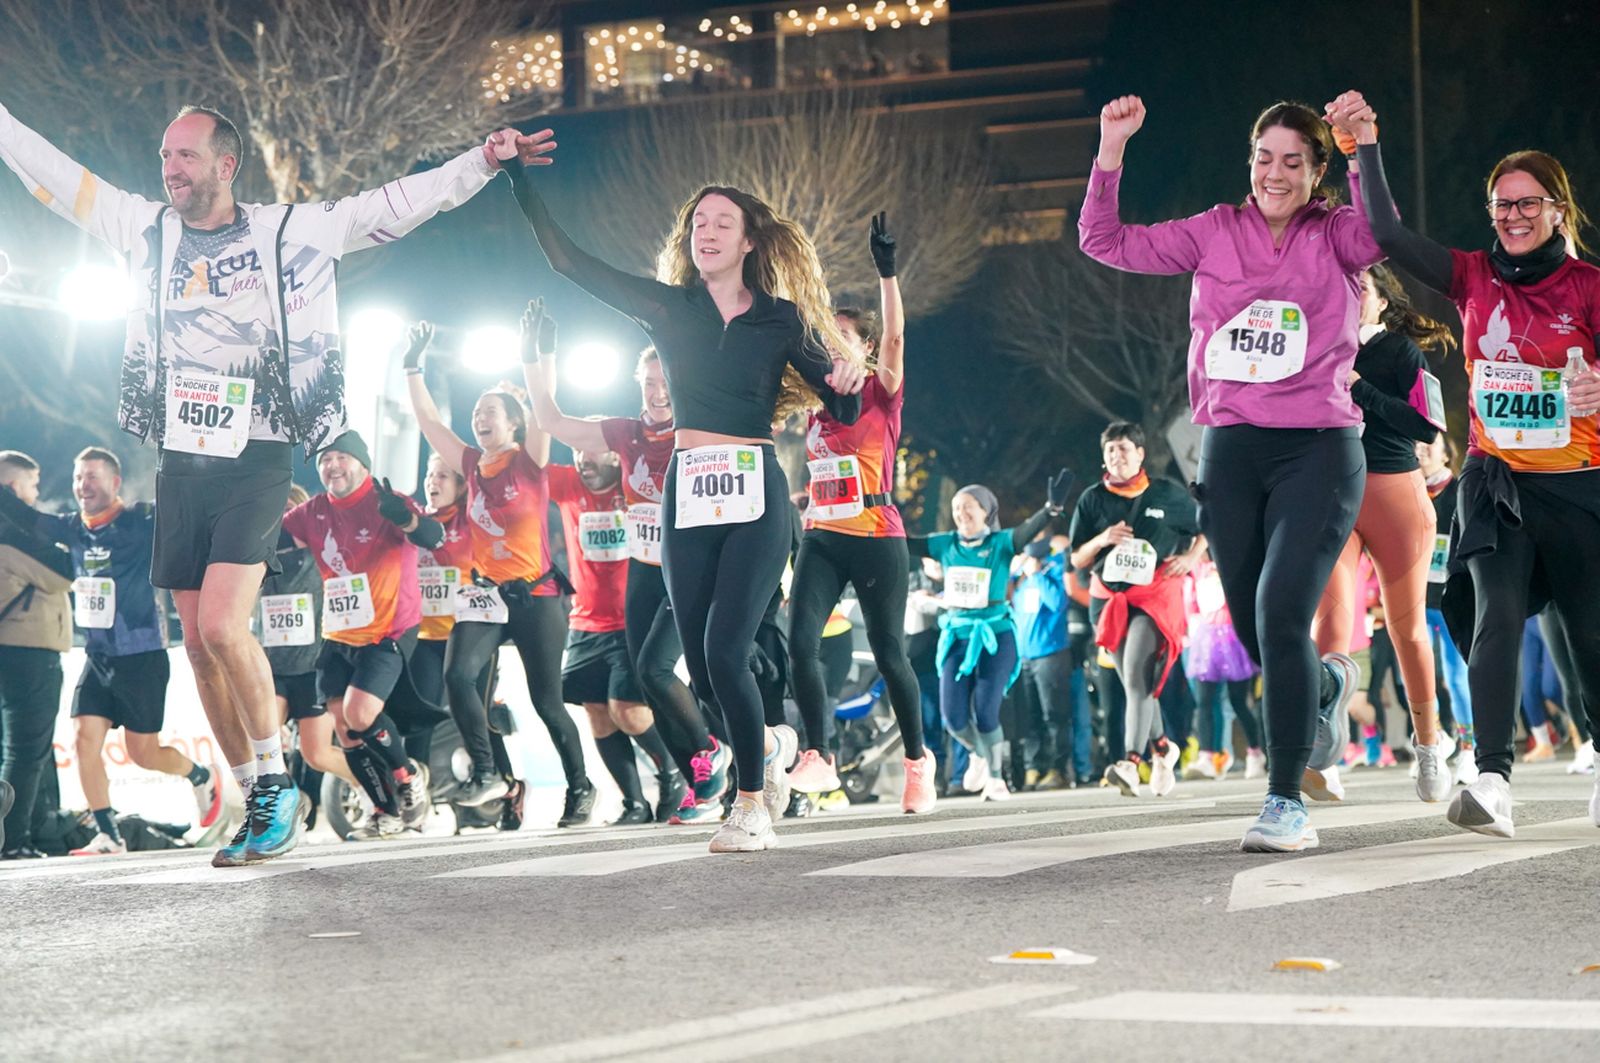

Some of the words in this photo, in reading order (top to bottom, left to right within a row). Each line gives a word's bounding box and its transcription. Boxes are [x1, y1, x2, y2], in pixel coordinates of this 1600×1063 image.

[1229, 328, 1286, 356] 1548
[1495, 371, 1521, 381] NOCHE
[1522, 372, 1533, 381] DE
[183, 381, 208, 391] NOCHE
[209, 383, 220, 392] DE
[1483, 381, 1499, 390] SAN
[174, 389, 188, 399] SAN
[1484, 392, 1556, 419] 12446
[178, 401, 234, 429] 4502
[693, 455, 718, 464] NOCHE
[720, 453, 729, 461] DE
[685, 465, 700, 476] SAN
[639, 480, 655, 497] 43
[692, 473, 744, 497] 4001
[587, 528, 625, 545] 12082
[636, 522, 661, 542] 1411
[1116, 553, 1146, 569] 6985
[419, 585, 449, 599] 7037
[328, 594, 360, 613] 4572
[270, 613, 304, 629] 5269
